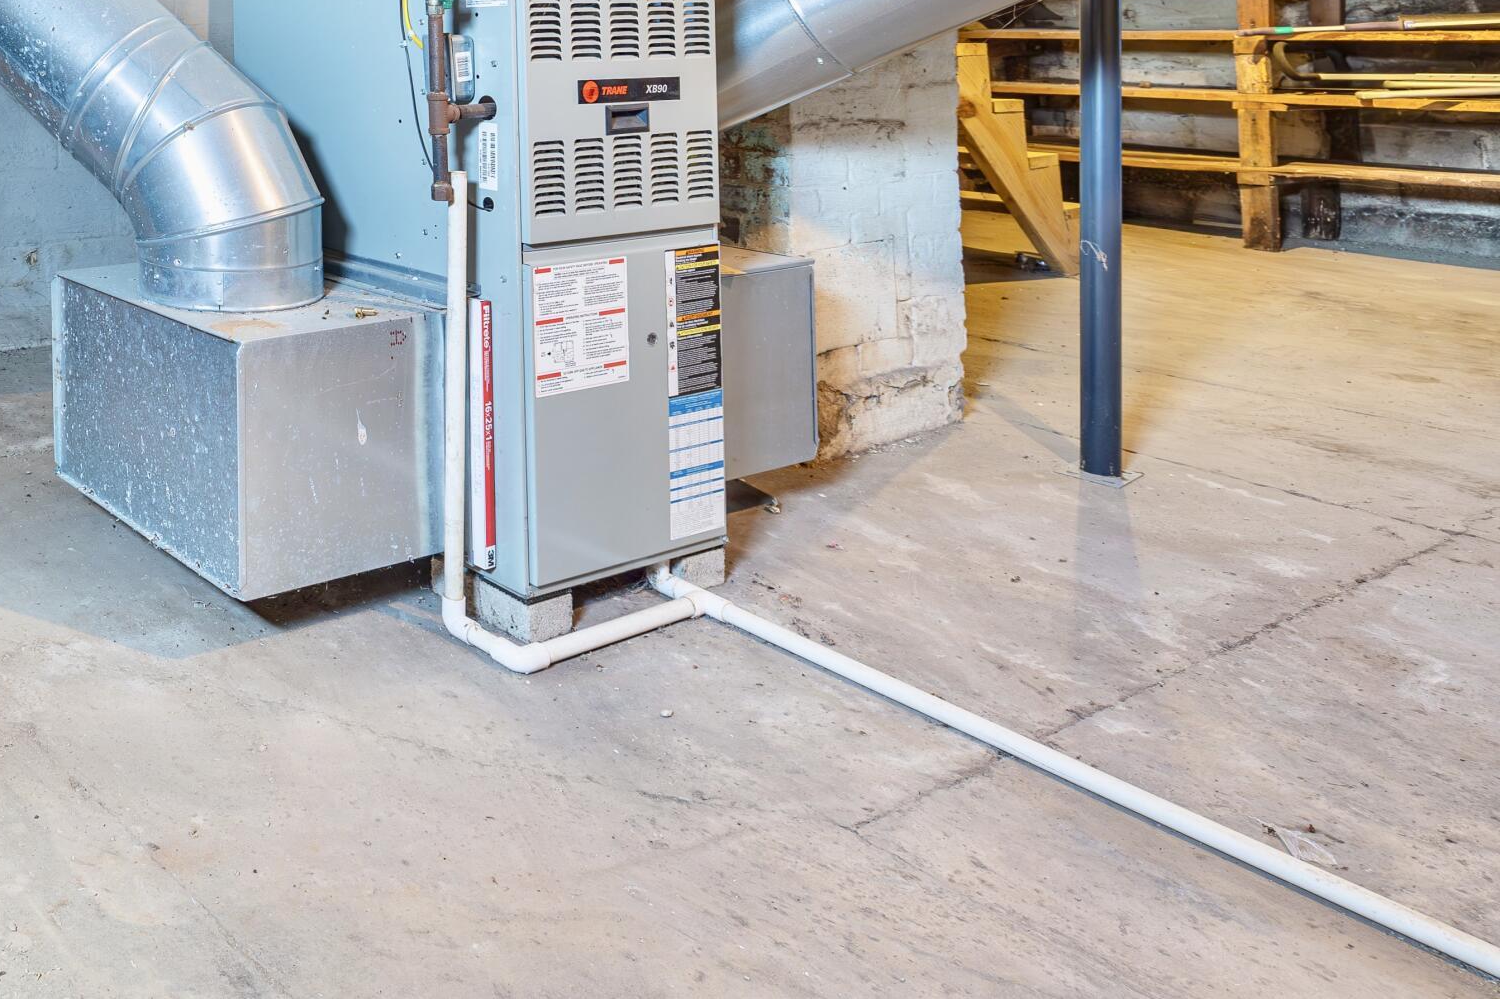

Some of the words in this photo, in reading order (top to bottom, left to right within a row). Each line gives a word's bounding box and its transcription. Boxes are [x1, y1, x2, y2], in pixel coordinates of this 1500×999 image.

[601, 85, 628, 95] TRANE
[645, 84, 668, 94] XB90
[483, 305, 491, 349] Filtrete
[487, 550, 495, 567] 3M
